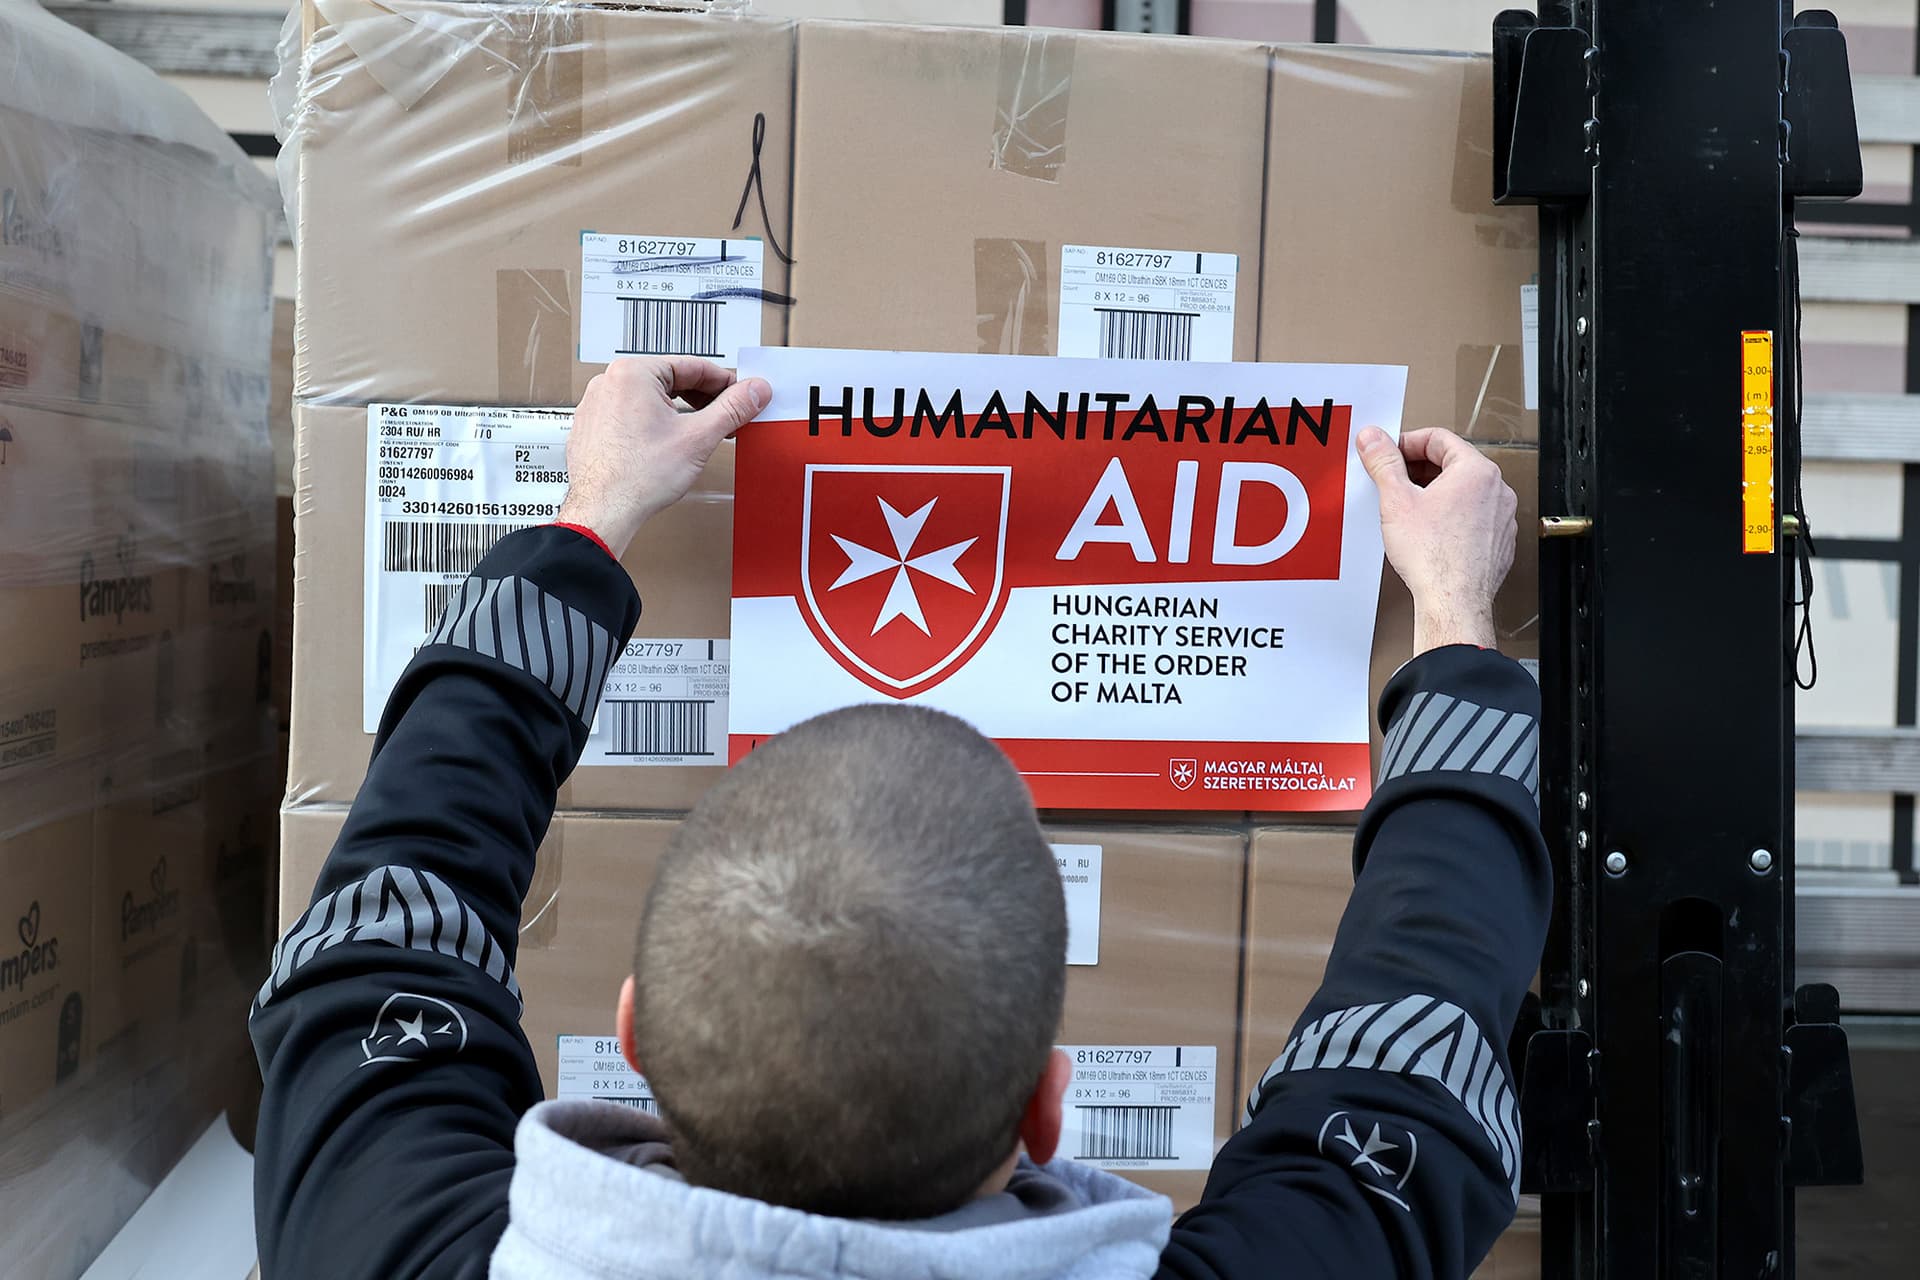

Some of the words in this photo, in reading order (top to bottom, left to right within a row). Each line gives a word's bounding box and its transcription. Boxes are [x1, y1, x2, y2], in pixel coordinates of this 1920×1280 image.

[618, 240, 696, 256] 81627797
[1096, 252, 1172, 268] 81627797
[726, 265, 739, 276] CEN
[740, 266, 754, 276] CES
[617, 280, 623, 289] 8
[626, 280, 634, 289] X
[638, 281, 648, 290] 12
[661, 282, 674, 291] 96
[1128, 274, 1150, 285] Ultrathin
[1168, 276, 1186, 287] 18mm
[1200, 278, 1214, 288] CEN
[1214, 278, 1228, 289] CES
[1094, 291, 1101, 300] 8
[1103, 292, 1111, 300] X
[1115, 293, 1126, 302] 12
[1137, 293, 1150, 303] 96
[381, 406, 408, 417] P&G
[807, 385, 1334, 447] HUMANITARIAN
[380, 426, 402, 436] 2304
[427, 427, 441, 437] HR
[380, 446, 434, 459] 81627797
[516, 450, 530, 462] P2
[380, 466, 474, 480] 03014260096984
[378, 485, 406, 497] 0024
[402, 501, 560, 516] 330142601561392981
[1054, 456, 1311, 566] AID
[1052, 594, 1218, 618] HUNGARIAN
[1052, 623, 1168, 646] CHARITY
[1175, 626, 1284, 648] SERVICE
[625, 644, 683, 657] 627797
[639, 664, 662, 674] Ultrathin
[680, 664, 698, 674] 18mm
[714, 664, 726, 674] CEN
[1052, 652, 1089, 673] OF
[1096, 654, 1146, 674] THE
[1154, 654, 1247, 676] ORDER
[605, 684, 612, 692] 8
[614, 684, 621, 692] X
[626, 684, 637, 692] 12
[649, 684, 662, 692] 96
[1052, 682, 1089, 703] OF
[1096, 682, 1182, 704] MALTA
[1204, 761, 1266, 774] MAGYAR
[1270, 759, 1323, 775] MÁLTAI
[1204, 775, 1356, 790] SZERETETSZOLGÁLAT
[1078, 859, 1089, 868] RU
[1077, 1050, 1152, 1064] 81627797
[1108, 1071, 1131, 1081] Ultrathin
[1149, 1071, 1166, 1080] 18mm
[1180, 1071, 1194, 1080] CEN
[1194, 1071, 1208, 1080] CES
[593, 1080, 600, 1089] 8
[603, 1080, 610, 1089] X
[614, 1081, 625, 1089] 12
[1076, 1089, 1082, 1098] 8
[1084, 1089, 1092, 1098] X
[1096, 1089, 1106, 1098] 12
[1118, 1089, 1131, 1098] 96
